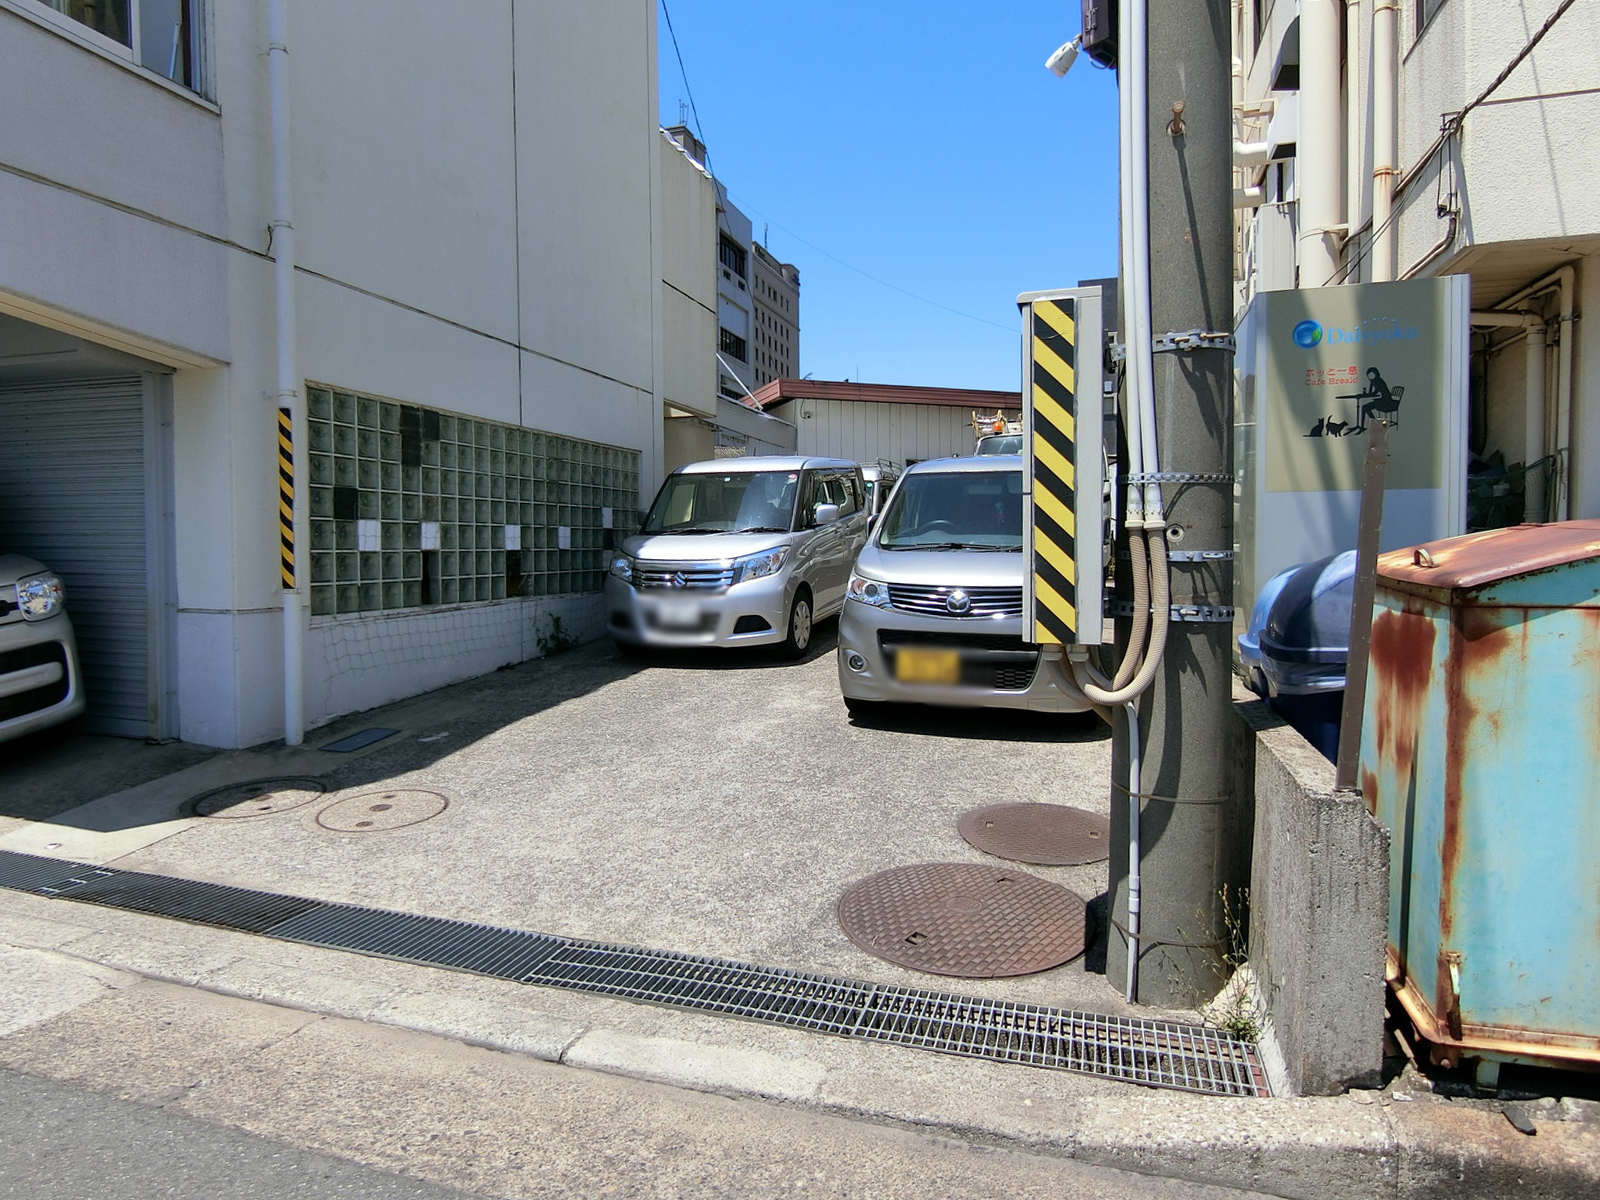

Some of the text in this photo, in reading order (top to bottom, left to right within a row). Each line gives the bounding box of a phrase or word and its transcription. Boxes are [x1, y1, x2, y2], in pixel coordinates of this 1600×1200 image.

[1305, 365, 1358, 377] ホッと一息
